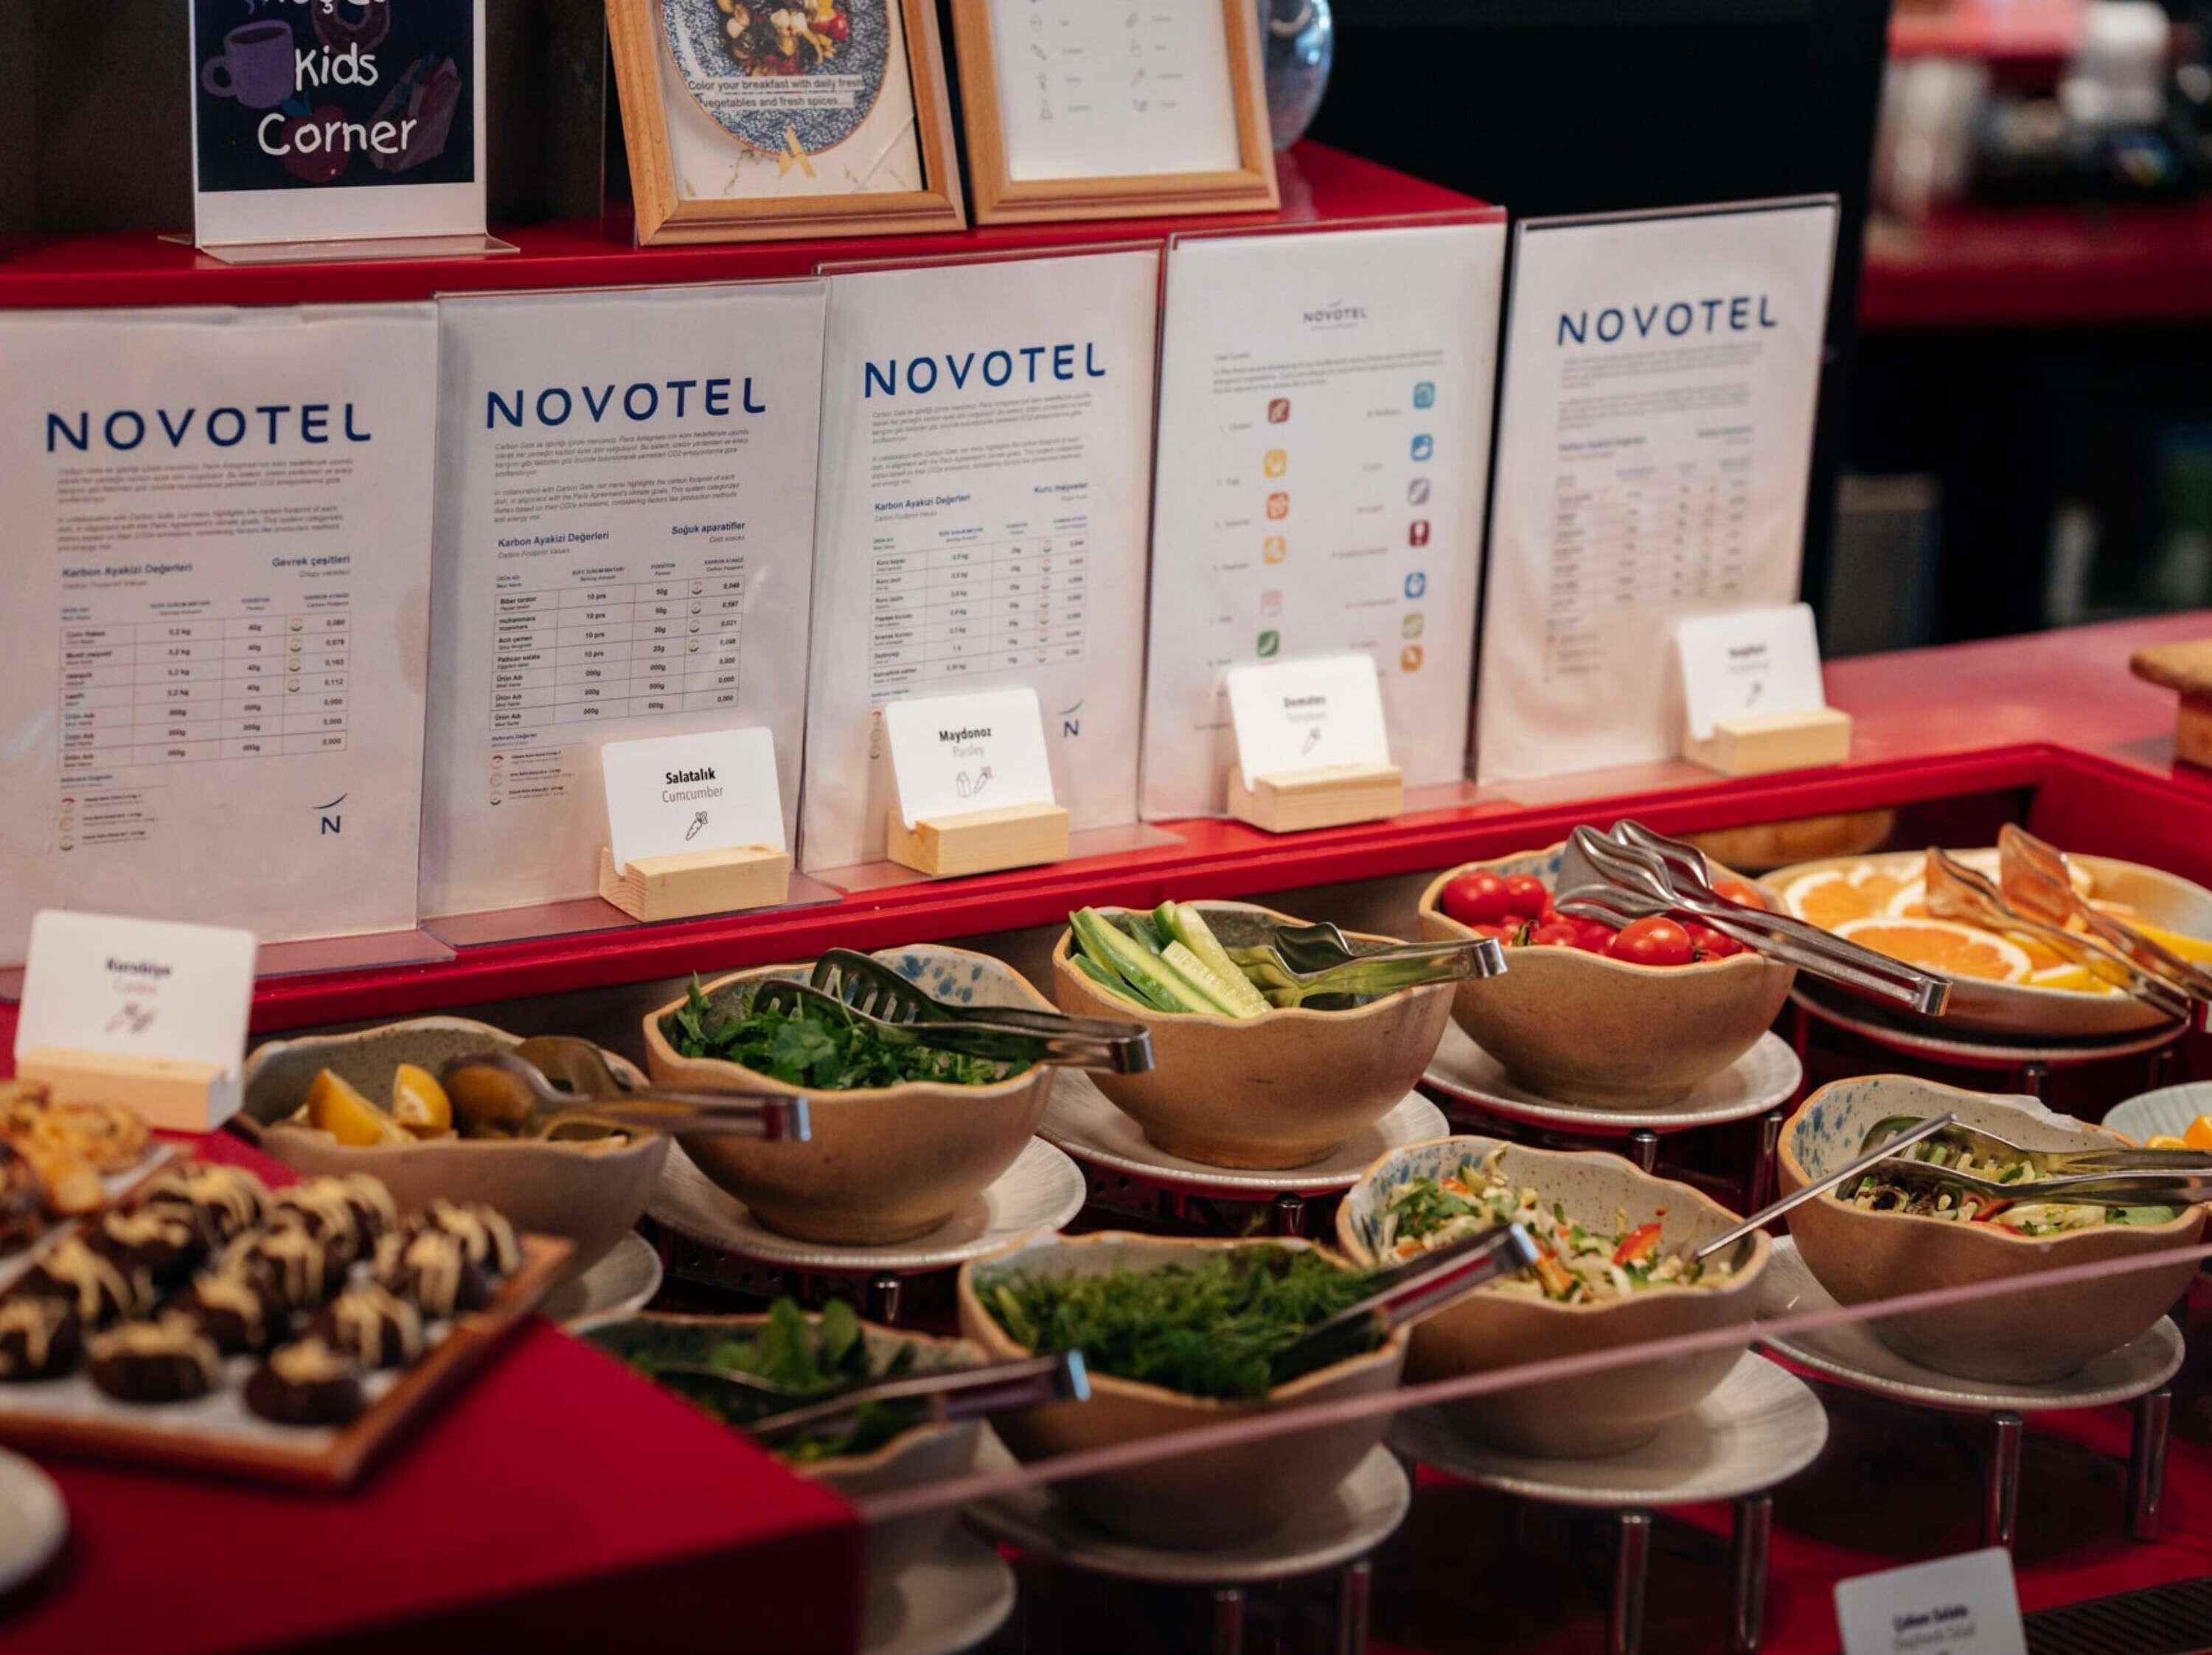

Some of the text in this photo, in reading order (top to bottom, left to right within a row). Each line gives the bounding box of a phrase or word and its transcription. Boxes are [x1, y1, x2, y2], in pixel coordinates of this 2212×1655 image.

[295, 42, 378, 91] Kids
[688, 80, 714, 90] Color
[717, 82, 739, 91] your
[742, 79, 789, 89] breakfast
[792, 77, 811, 88] with
[813, 77, 835, 90] daily
[703, 97, 757, 108] vegetables
[759, 97, 778, 106] and
[780, 96, 804, 105] fresh
[257, 113, 417, 156] Corner
[1303, 307, 1368, 324] NOVOTEL
[1557, 295, 1777, 346] NOVOTEL
[864, 342, 1105, 398] NOVOTEL
[487, 377, 766, 429] NOVOTEL
[47, 403, 371, 452] NOVOTEL
[874, 501, 903, 511] Karbon
[905, 498, 933, 509] Ayakizi
[672, 521, 745, 536] Soğuk aparatifler
[498, 531, 609, 548] Karbon Ayakizi Değerleri
[271, 554, 350, 568] Gevrek çeşitleri
[62, 568, 102, 577] Karbon
[939, 727, 992, 743] Maydonoz
[1062, 720, 1079, 737] N
[953, 744, 984, 759] Parsley
[665, 767, 716, 785] Salatalık
[661, 785, 723, 804] Cumcumber
[320, 814, 341, 835] N
